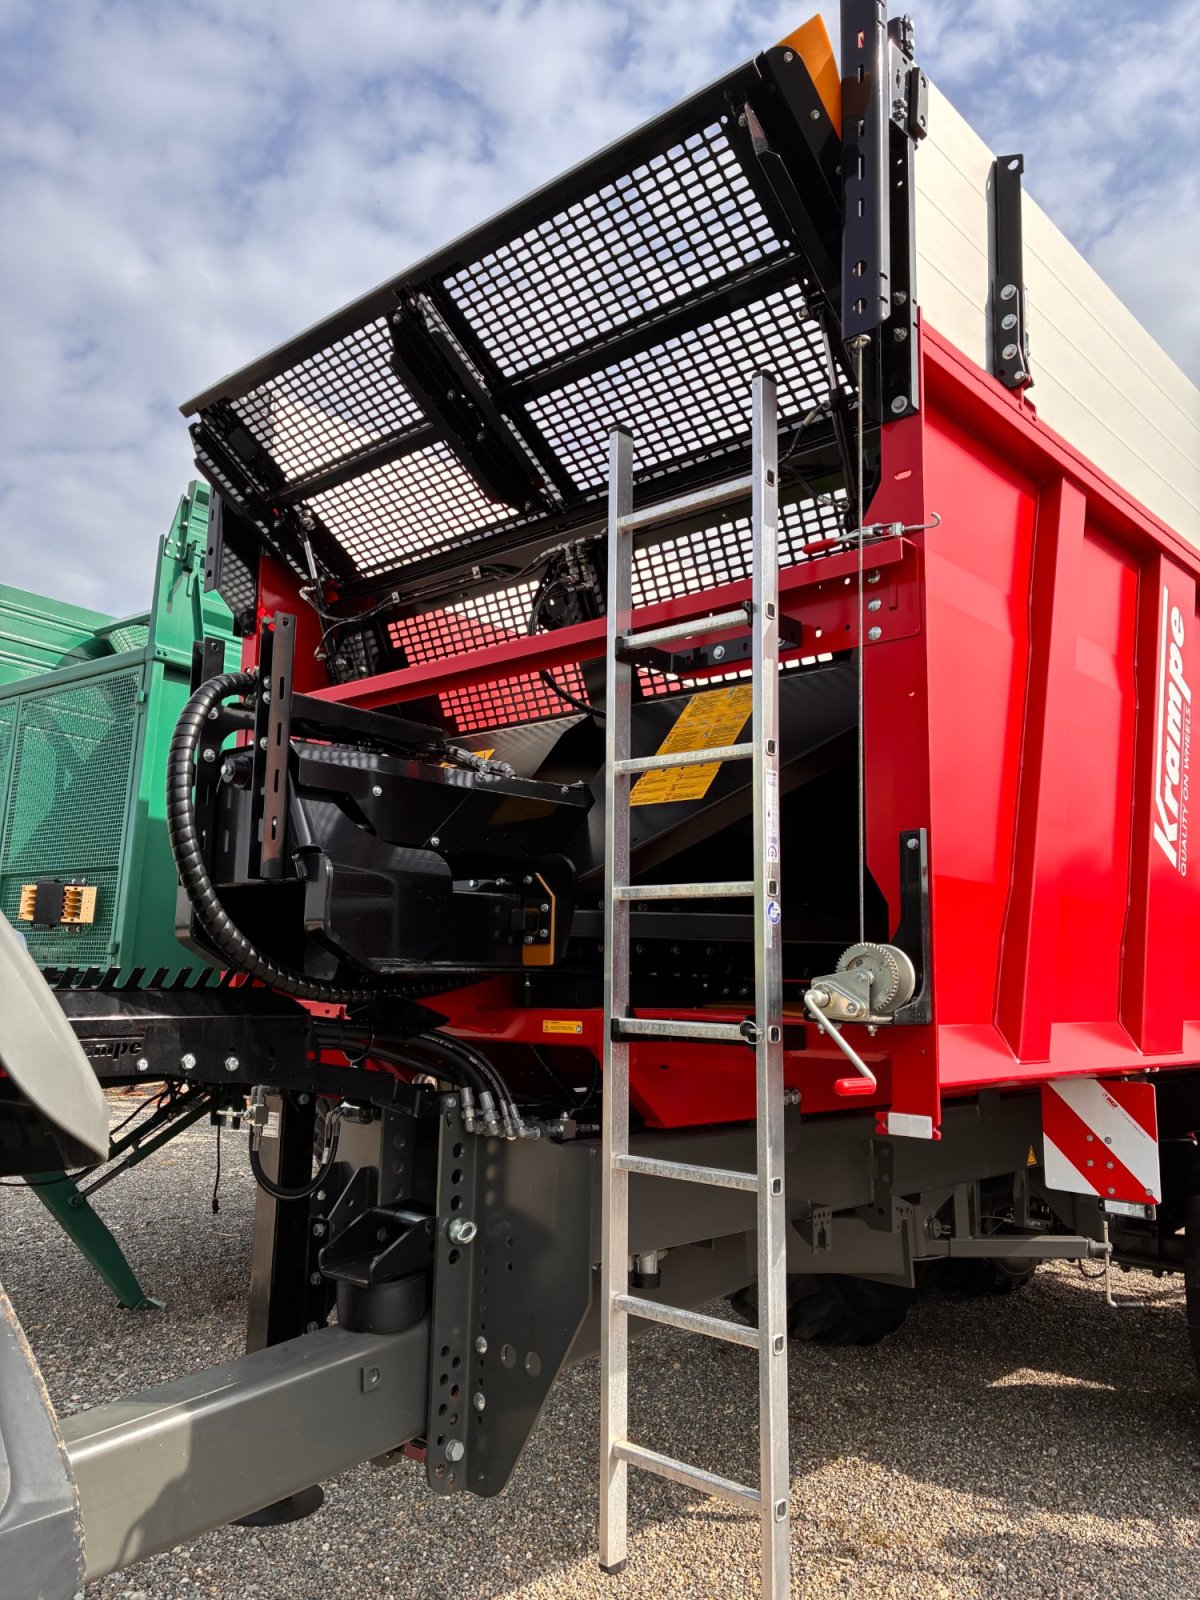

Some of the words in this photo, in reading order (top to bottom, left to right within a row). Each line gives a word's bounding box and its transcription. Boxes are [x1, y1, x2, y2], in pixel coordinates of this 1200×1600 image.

[1153, 585, 1191, 868] Krampe
[1183, 705, 1191, 769] WHEELS
[1183, 773, 1189, 801] ON
